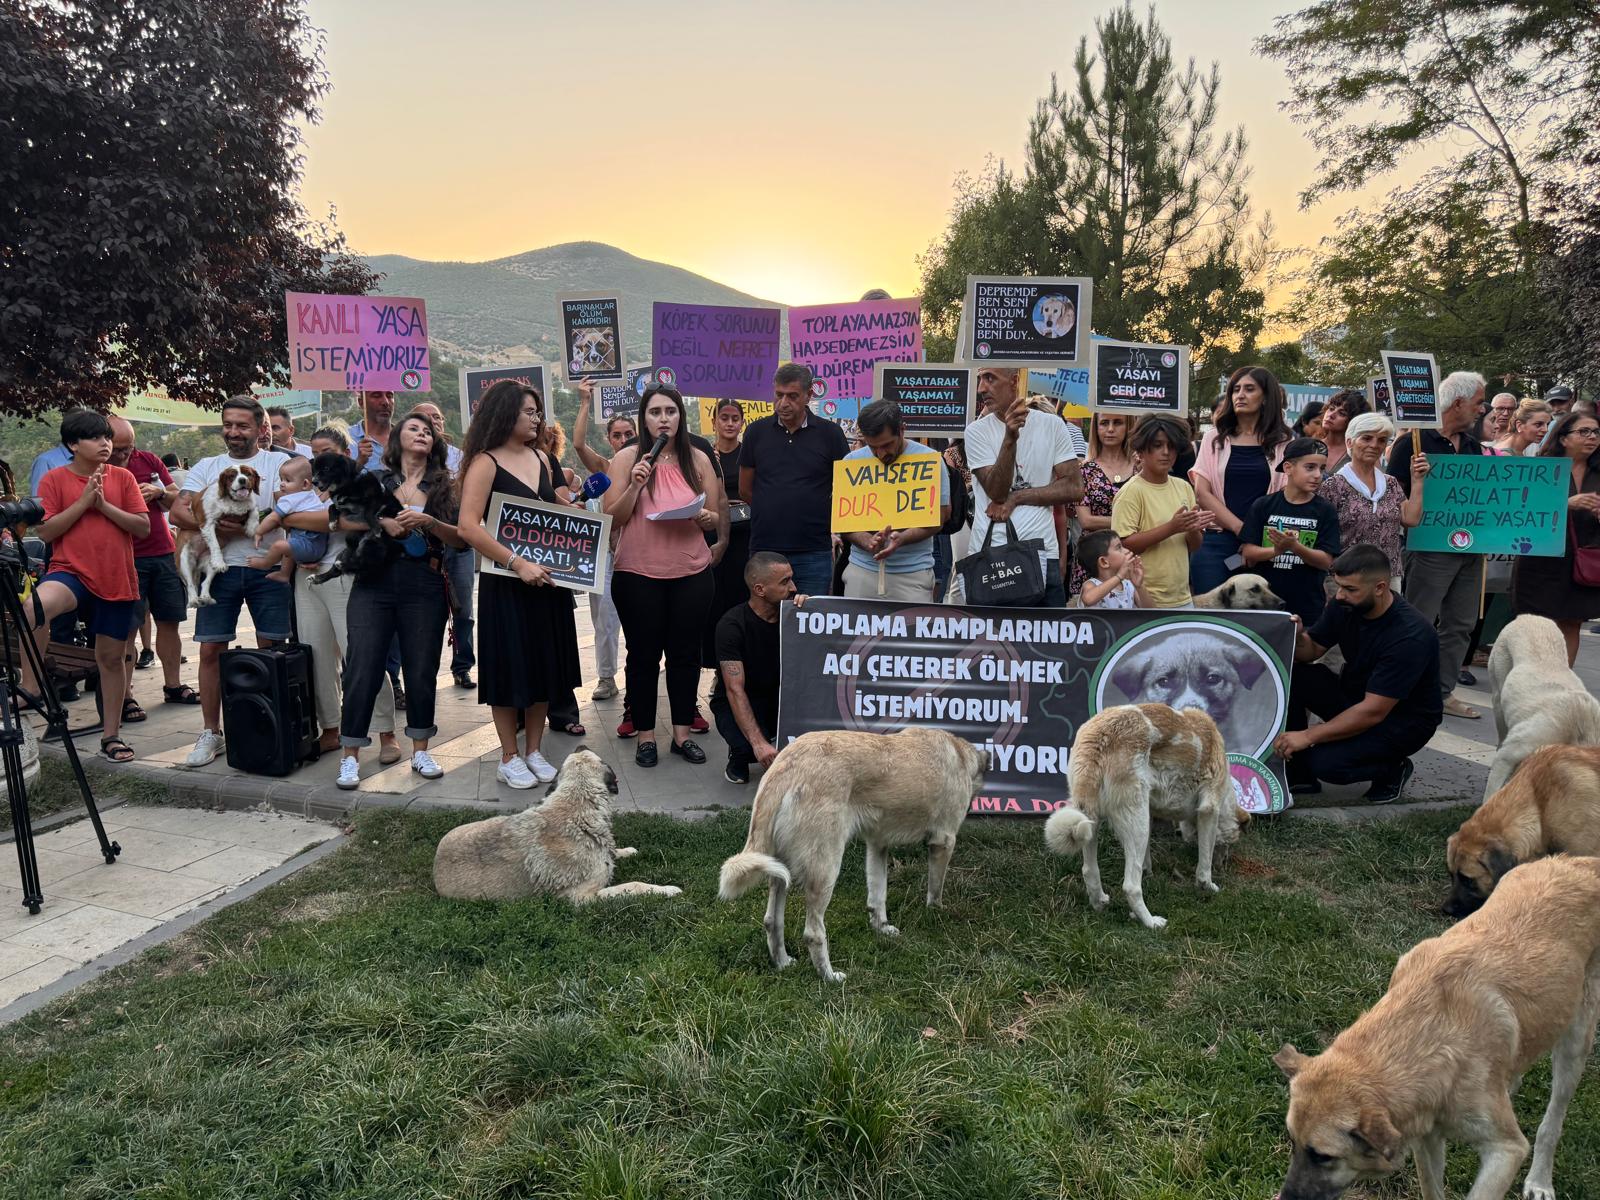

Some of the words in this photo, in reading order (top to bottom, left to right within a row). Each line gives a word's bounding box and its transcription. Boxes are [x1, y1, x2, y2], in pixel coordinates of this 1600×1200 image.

[978, 297, 1000, 307] BEN
[1004, 297, 1028, 307] SENİ
[980, 287, 1037, 296] DEPREMDE
[567, 303, 614, 311] BARINAKLAR
[978, 308, 1027, 319] DUYDUM,
[297, 303, 360, 334] KANLI
[371, 304, 425, 337] YASA
[661, 309, 708, 332] KÖPEK
[713, 314, 777, 335] SORUNU
[802, 307, 921, 334] TOPLAYAMAZSIN
[977, 319, 1014, 329] SENDE
[793, 331, 915, 358] HAPSEDEMEZSİN
[977, 329, 1002, 340] BENİ
[297, 342, 428, 372] İSTEMİYORUZ
[717, 340, 778, 359] NEFRET
[895, 376, 959, 387] YAŞATARAK
[1116, 368, 1161, 381] YASAYI
[898, 390, 954, 403] YAŞAMAYI
[1109, 384, 1137, 397] GERİ
[1138, 386, 1166, 400] ÇEK!
[840, 493, 883, 518] DUR
[502, 508, 561, 530] YASAYA
[565, 517, 600, 537] İNAT
[1267, 514, 1318, 530] MINECRAFT
[501, 522, 593, 554] ÖLDÜRME
[510, 543, 571, 566] YAŞAT!
[990, 561, 1006, 569] THE
[796, 611, 907, 638] TOPLAMA
[915, 616, 1095, 645] KAMPLARINDA
[822, 653, 860, 676] ACI
[866, 654, 973, 682] ÇEKEREK
[979, 655, 1063, 684] ÖLMEK
[854, 690, 1029, 724] İSTEMİYORUM.
[973, 738, 1073, 775] İYORU
